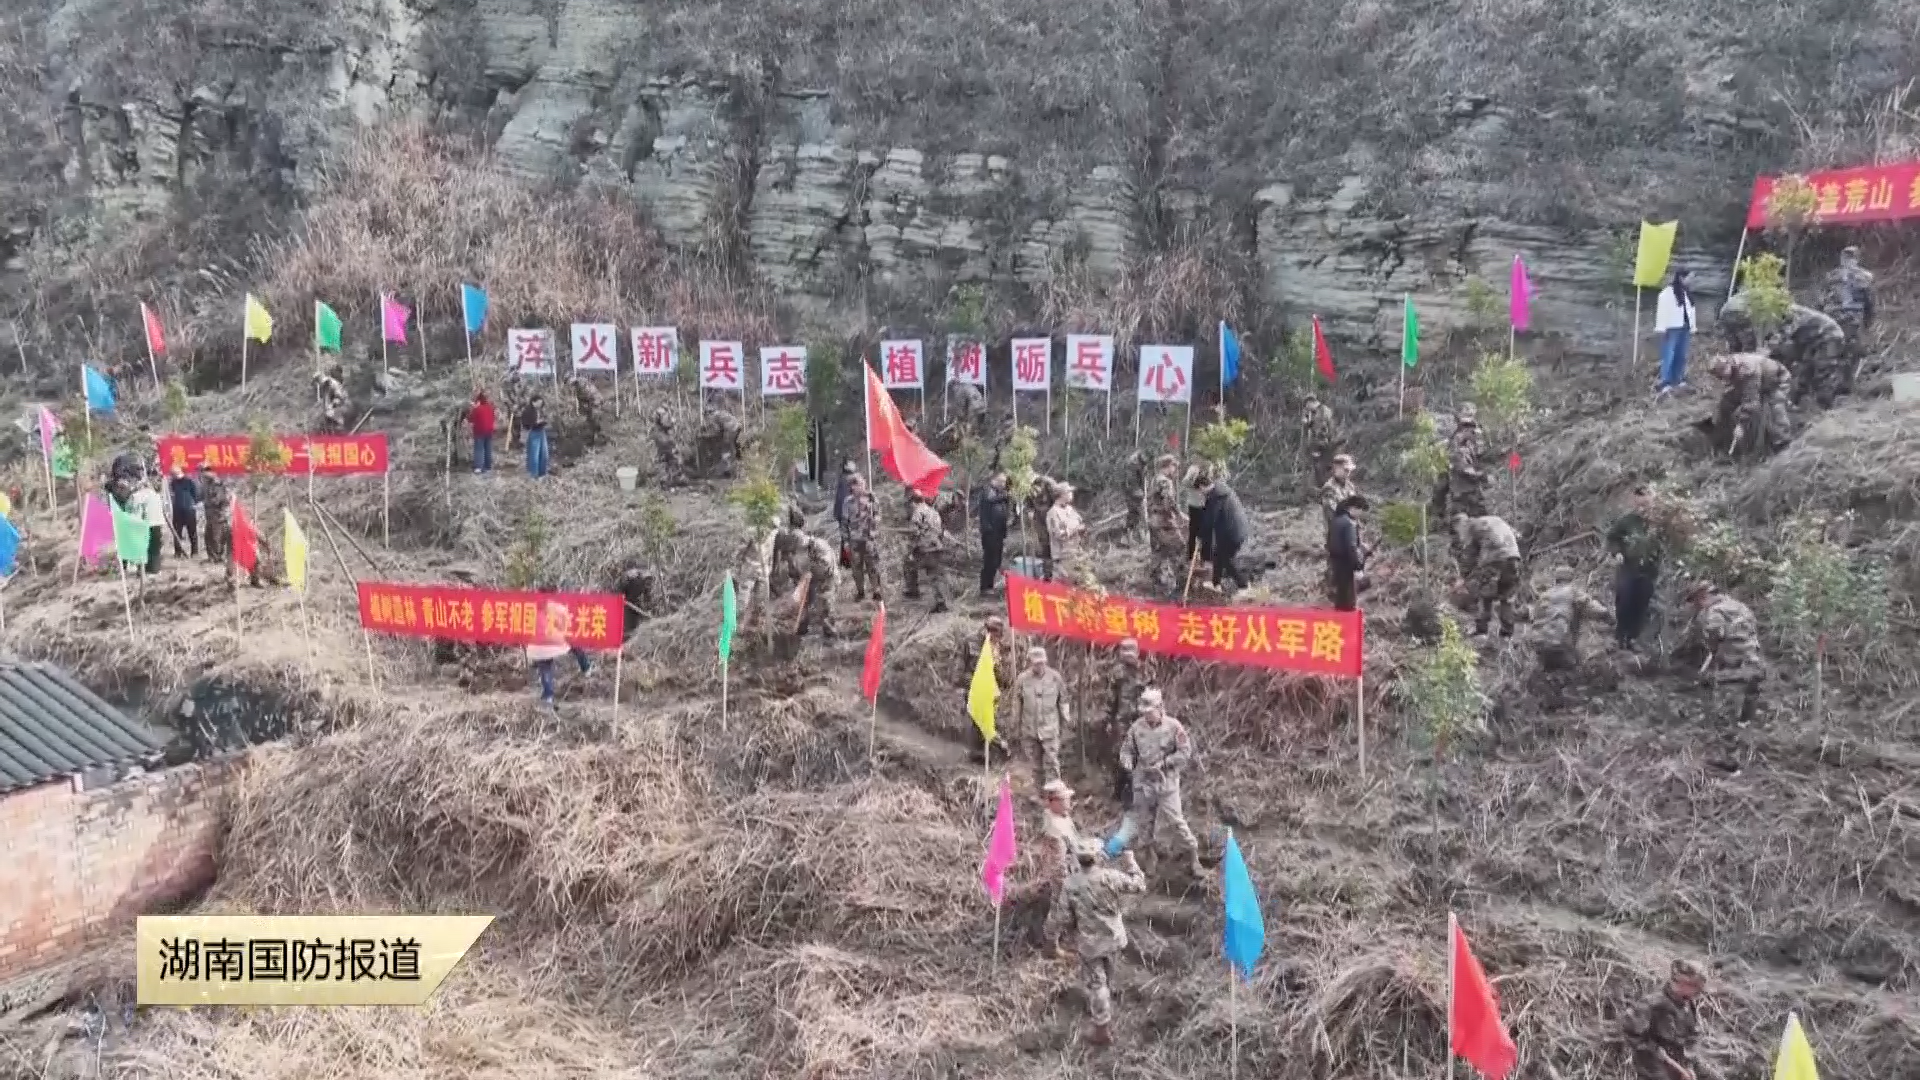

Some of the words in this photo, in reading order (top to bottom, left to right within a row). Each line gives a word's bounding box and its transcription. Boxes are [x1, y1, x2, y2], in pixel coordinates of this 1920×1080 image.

[1767, 176, 1894, 215] 盖荒山
[422, 597, 474, 631] 青山不老
[481, 598, 538, 635] 参军报国
[1177, 611, 1345, 662] 走好从军路
